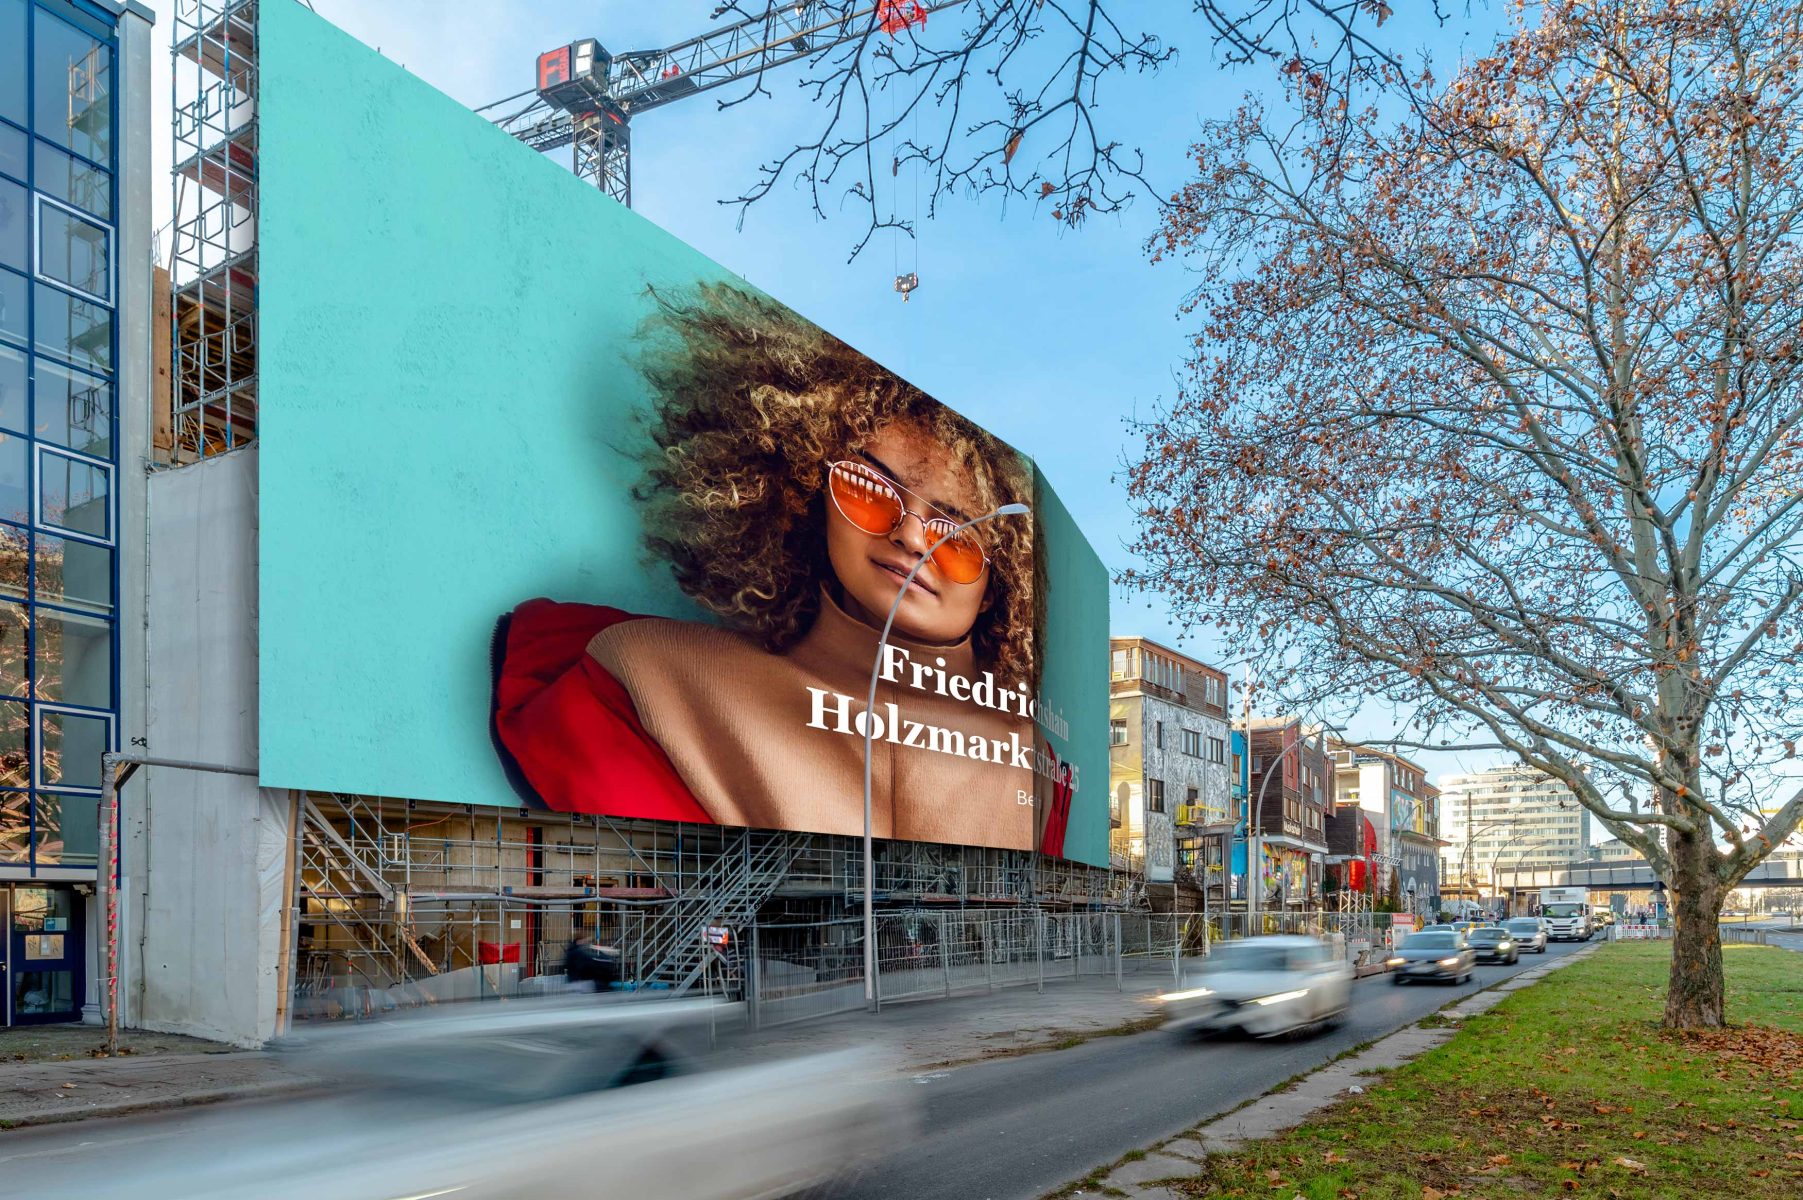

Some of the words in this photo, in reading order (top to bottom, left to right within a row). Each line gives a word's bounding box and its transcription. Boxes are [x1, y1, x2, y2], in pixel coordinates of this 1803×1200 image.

[805, 686, 1067, 787] Holzmarktstraße
[1069, 761, 1080, 793] 25
[878, 641, 1069, 742] Friedrichshain
